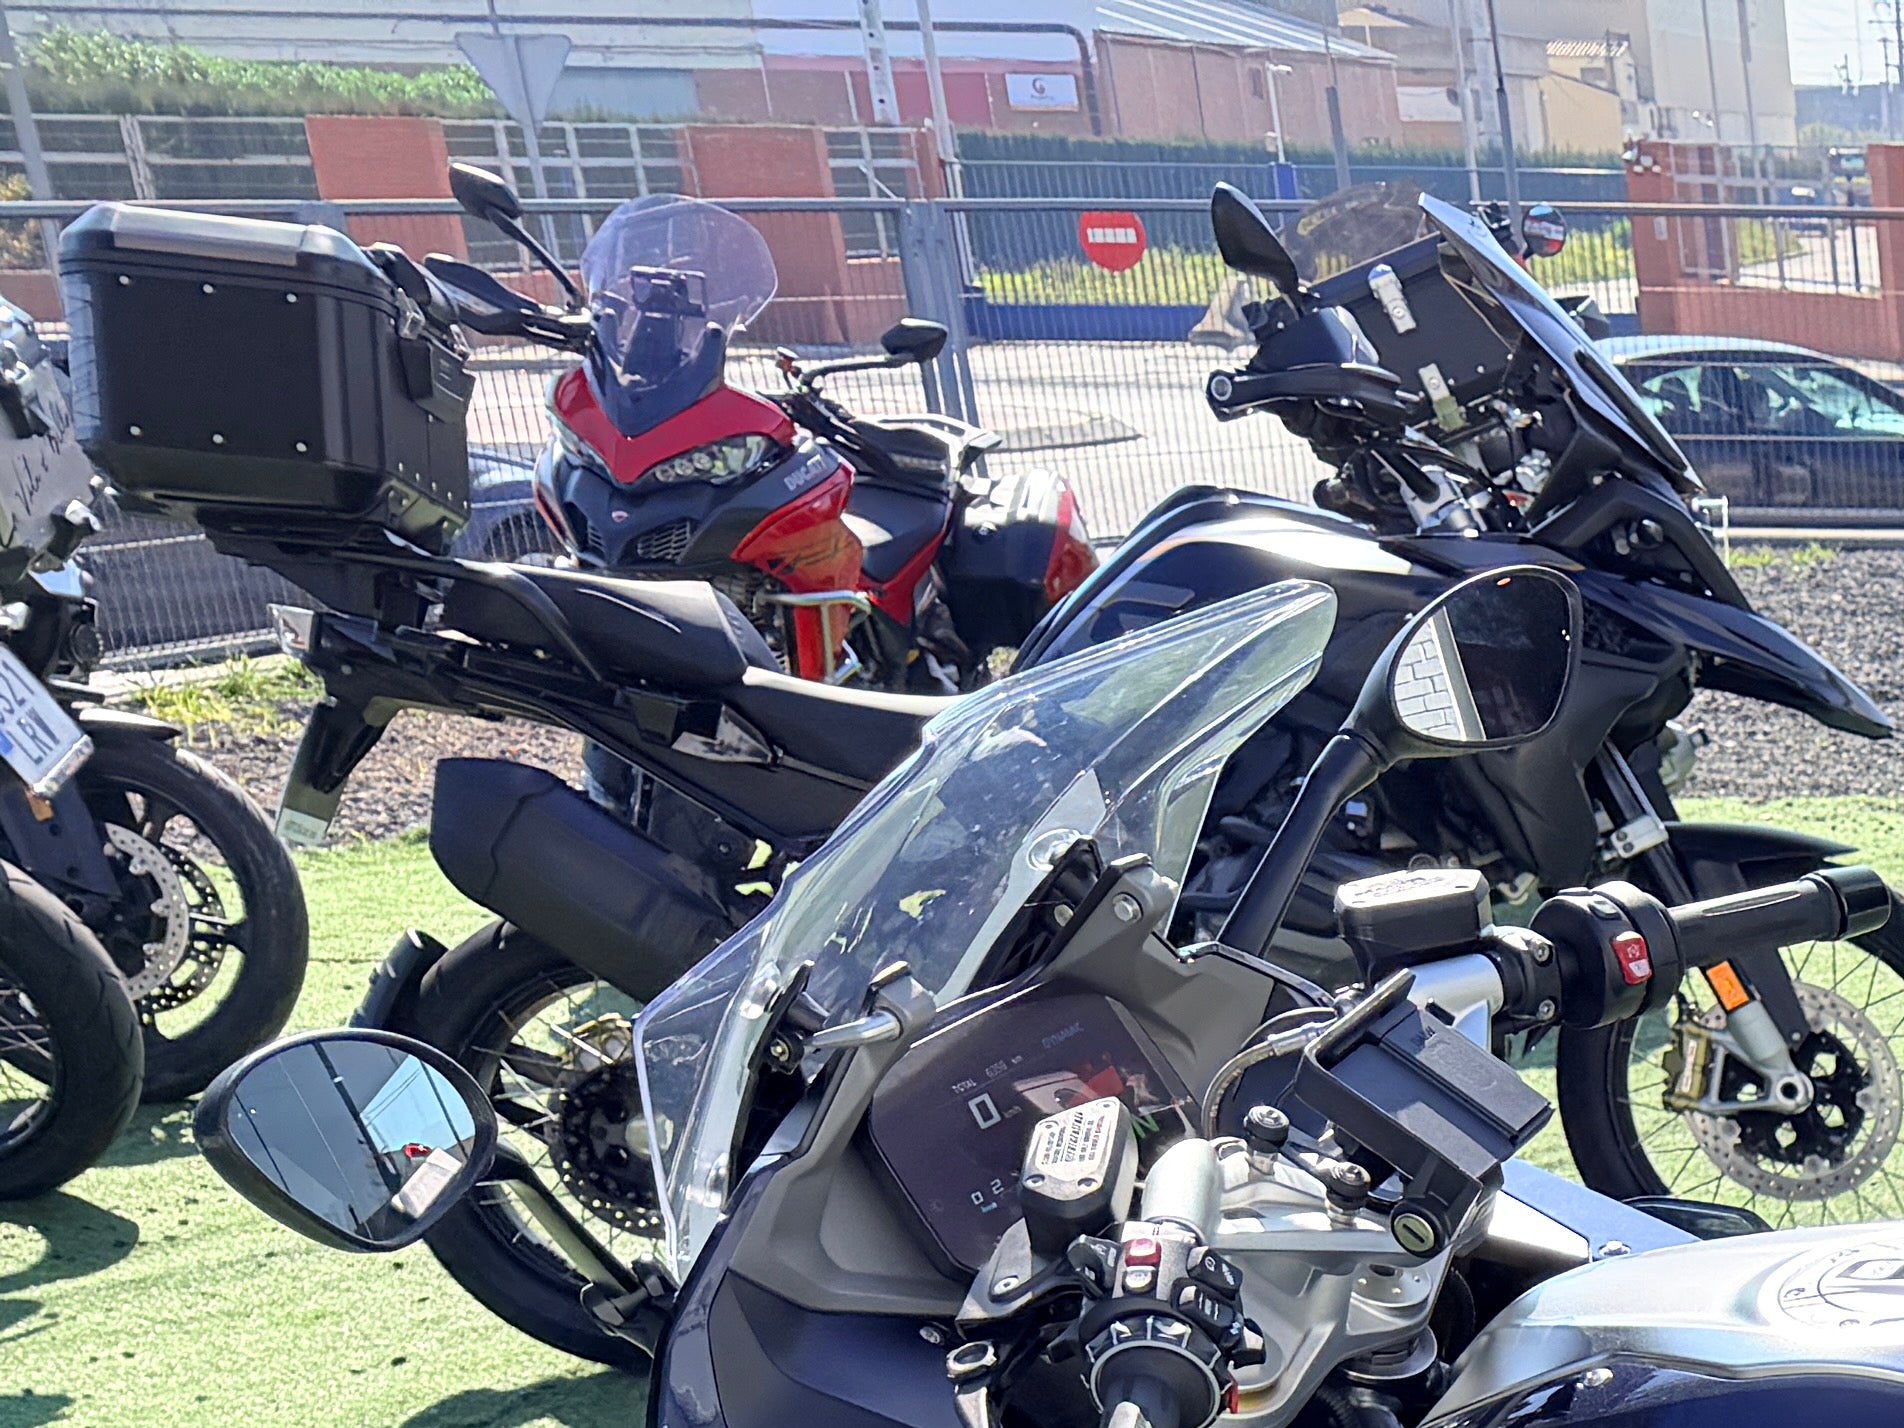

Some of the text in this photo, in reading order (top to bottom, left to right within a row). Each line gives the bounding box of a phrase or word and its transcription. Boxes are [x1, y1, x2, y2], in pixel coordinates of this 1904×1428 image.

[783, 453, 827, 491] DUCATI
[968, 1092, 1002, 1130] 0
[990, 1178, 1004, 1195] 2
